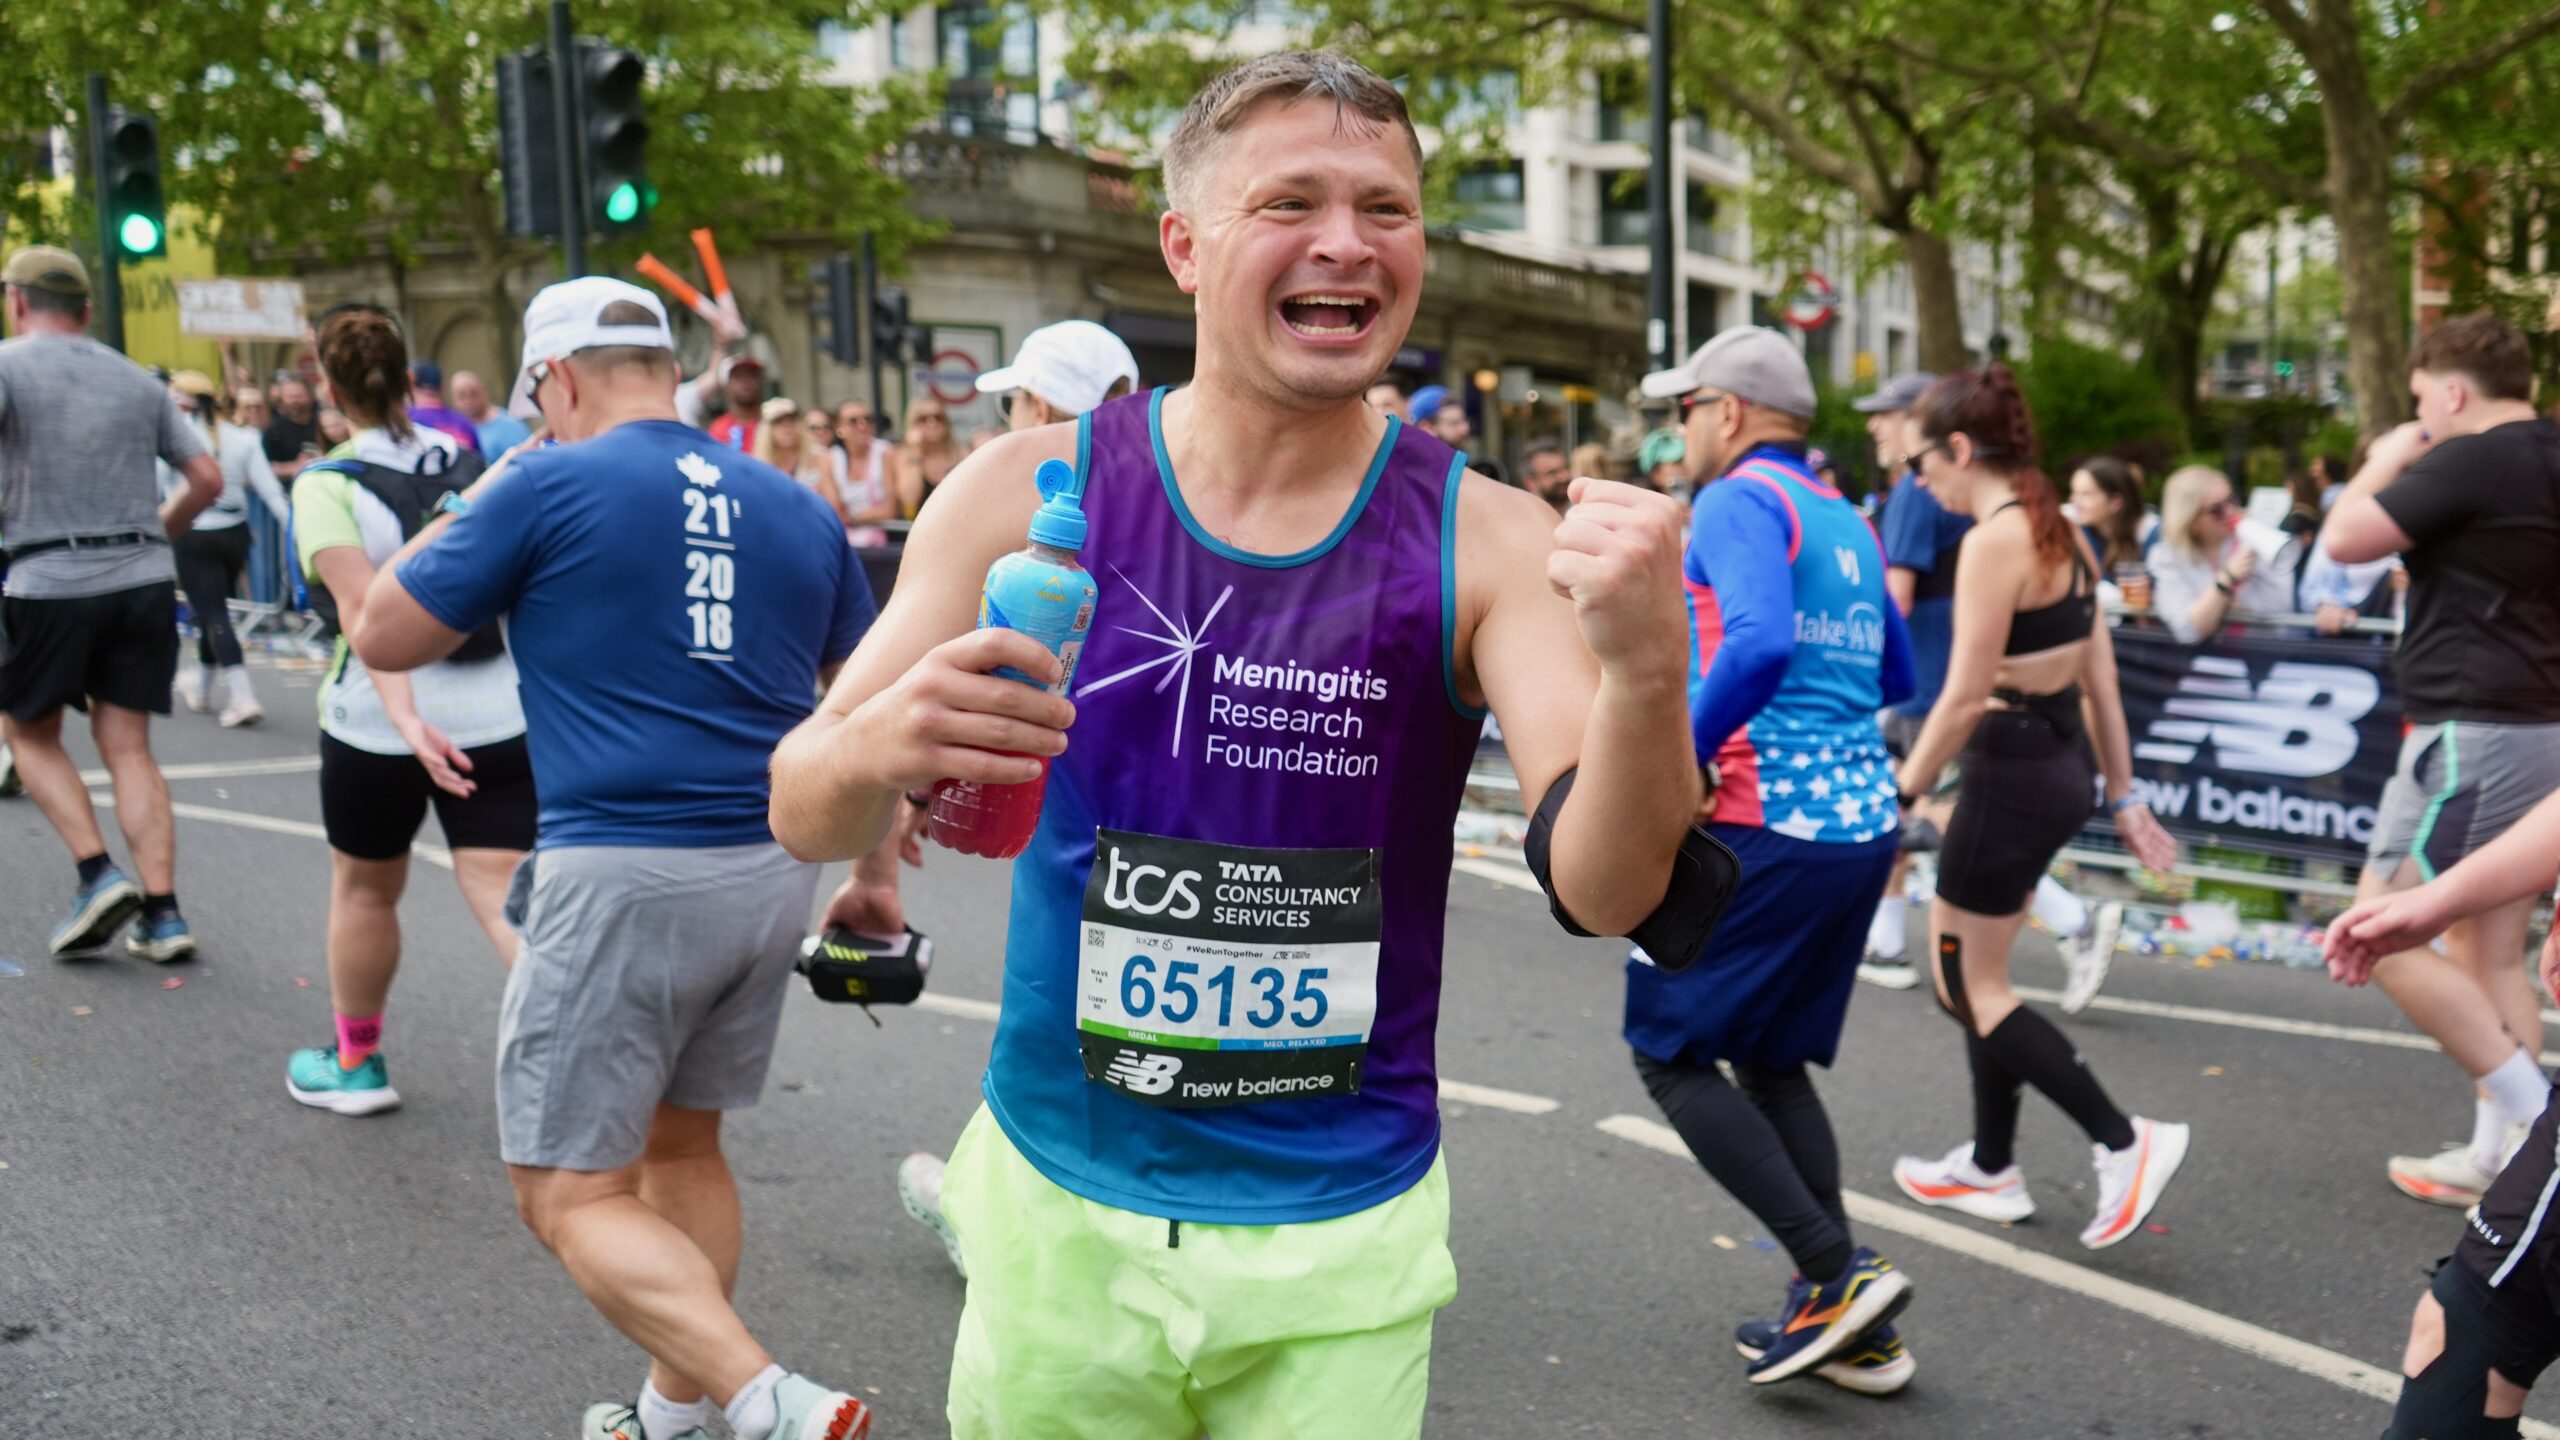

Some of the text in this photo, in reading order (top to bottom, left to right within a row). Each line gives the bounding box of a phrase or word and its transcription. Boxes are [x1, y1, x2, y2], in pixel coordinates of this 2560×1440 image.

[685, 551, 735, 601] 20
[686, 601, 734, 651] 18
[1213, 653, 1388, 701] Meningitis
[1209, 693, 1363, 740] Research
[1206, 734, 1379, 777] Foundation
[2197, 778, 2378, 845] balanc
[1218, 860, 1283, 883] TATA
[1214, 884, 1362, 906] CONSULTANCY
[1212, 906, 1311, 928] SERVICES
[1186, 944, 1264, 960] #WeRunTogether
[1120, 955, 1329, 1029] 65135
[1127, 1030, 1159, 1043] MEDAL
[1288, 1038, 1327, 1048] RELAXED
[1182, 1073, 1335, 1098] new balance
